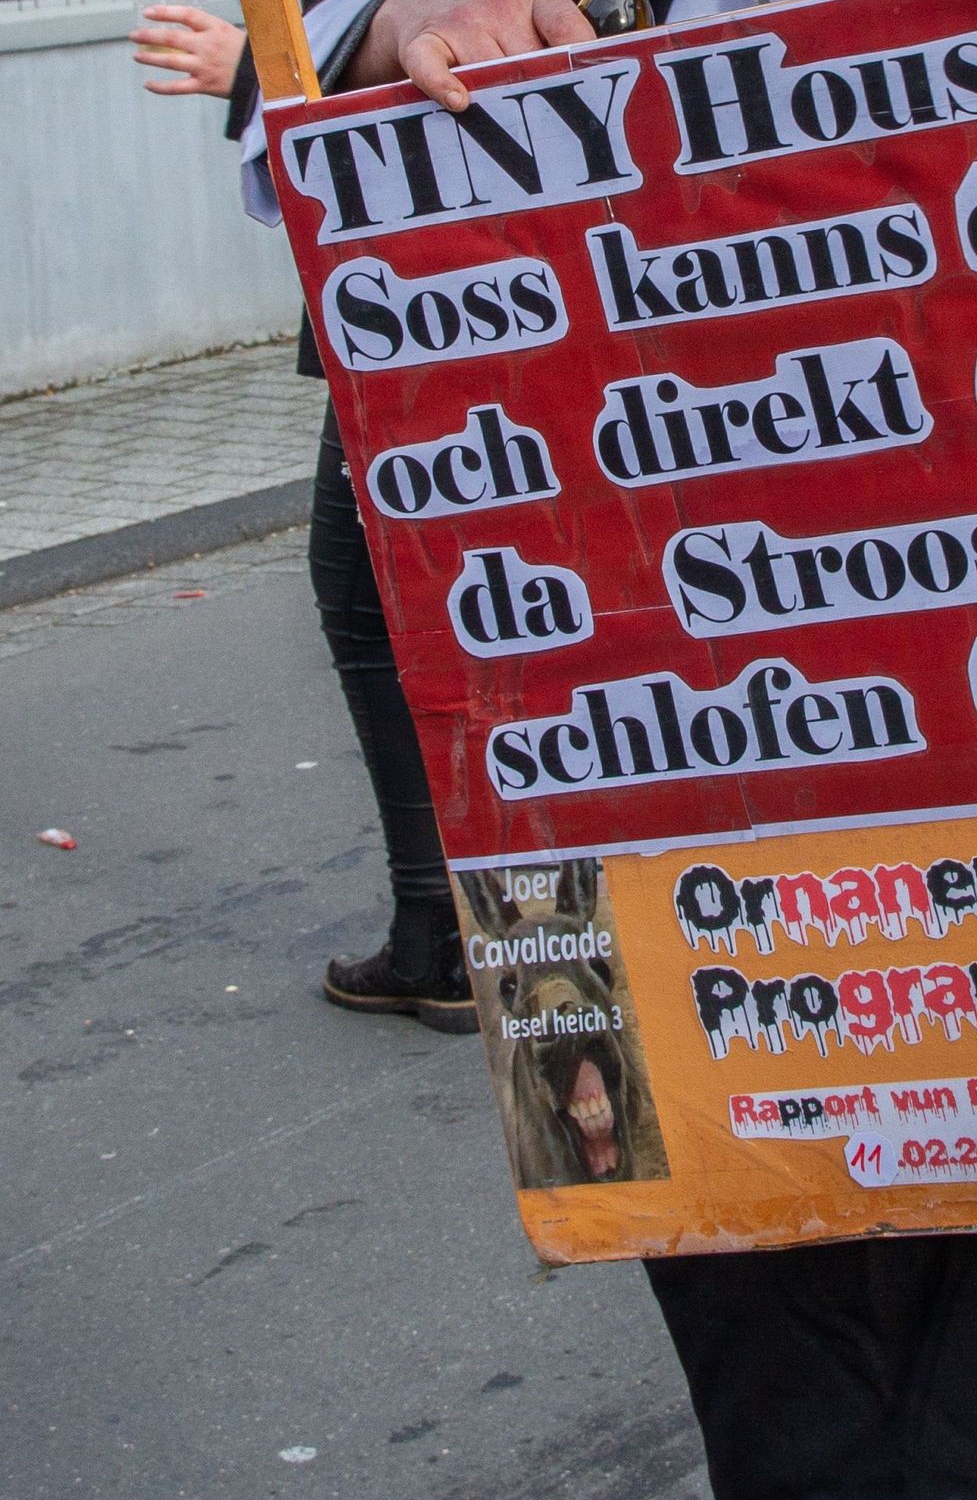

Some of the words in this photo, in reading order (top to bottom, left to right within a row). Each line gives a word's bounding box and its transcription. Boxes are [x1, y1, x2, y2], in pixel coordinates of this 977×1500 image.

[292, 71, 633, 234] TINY
[336, 268, 558, 367] Soss
[592, 209, 930, 324] kanns
[377, 408, 556, 514] och
[598, 348, 925, 481] direkt
[459, 552, 583, 643] da
[492, 666, 919, 793] schlofen
[502, 867, 560, 904] Joer
[468, 921, 613, 970] Cavalcade
[553, 1004, 607, 1036] heich
[611, 1005, 624, 1031] 3
[731, 1085, 883, 1137] Rapport
[890, 1086, 958, 1124] vun
